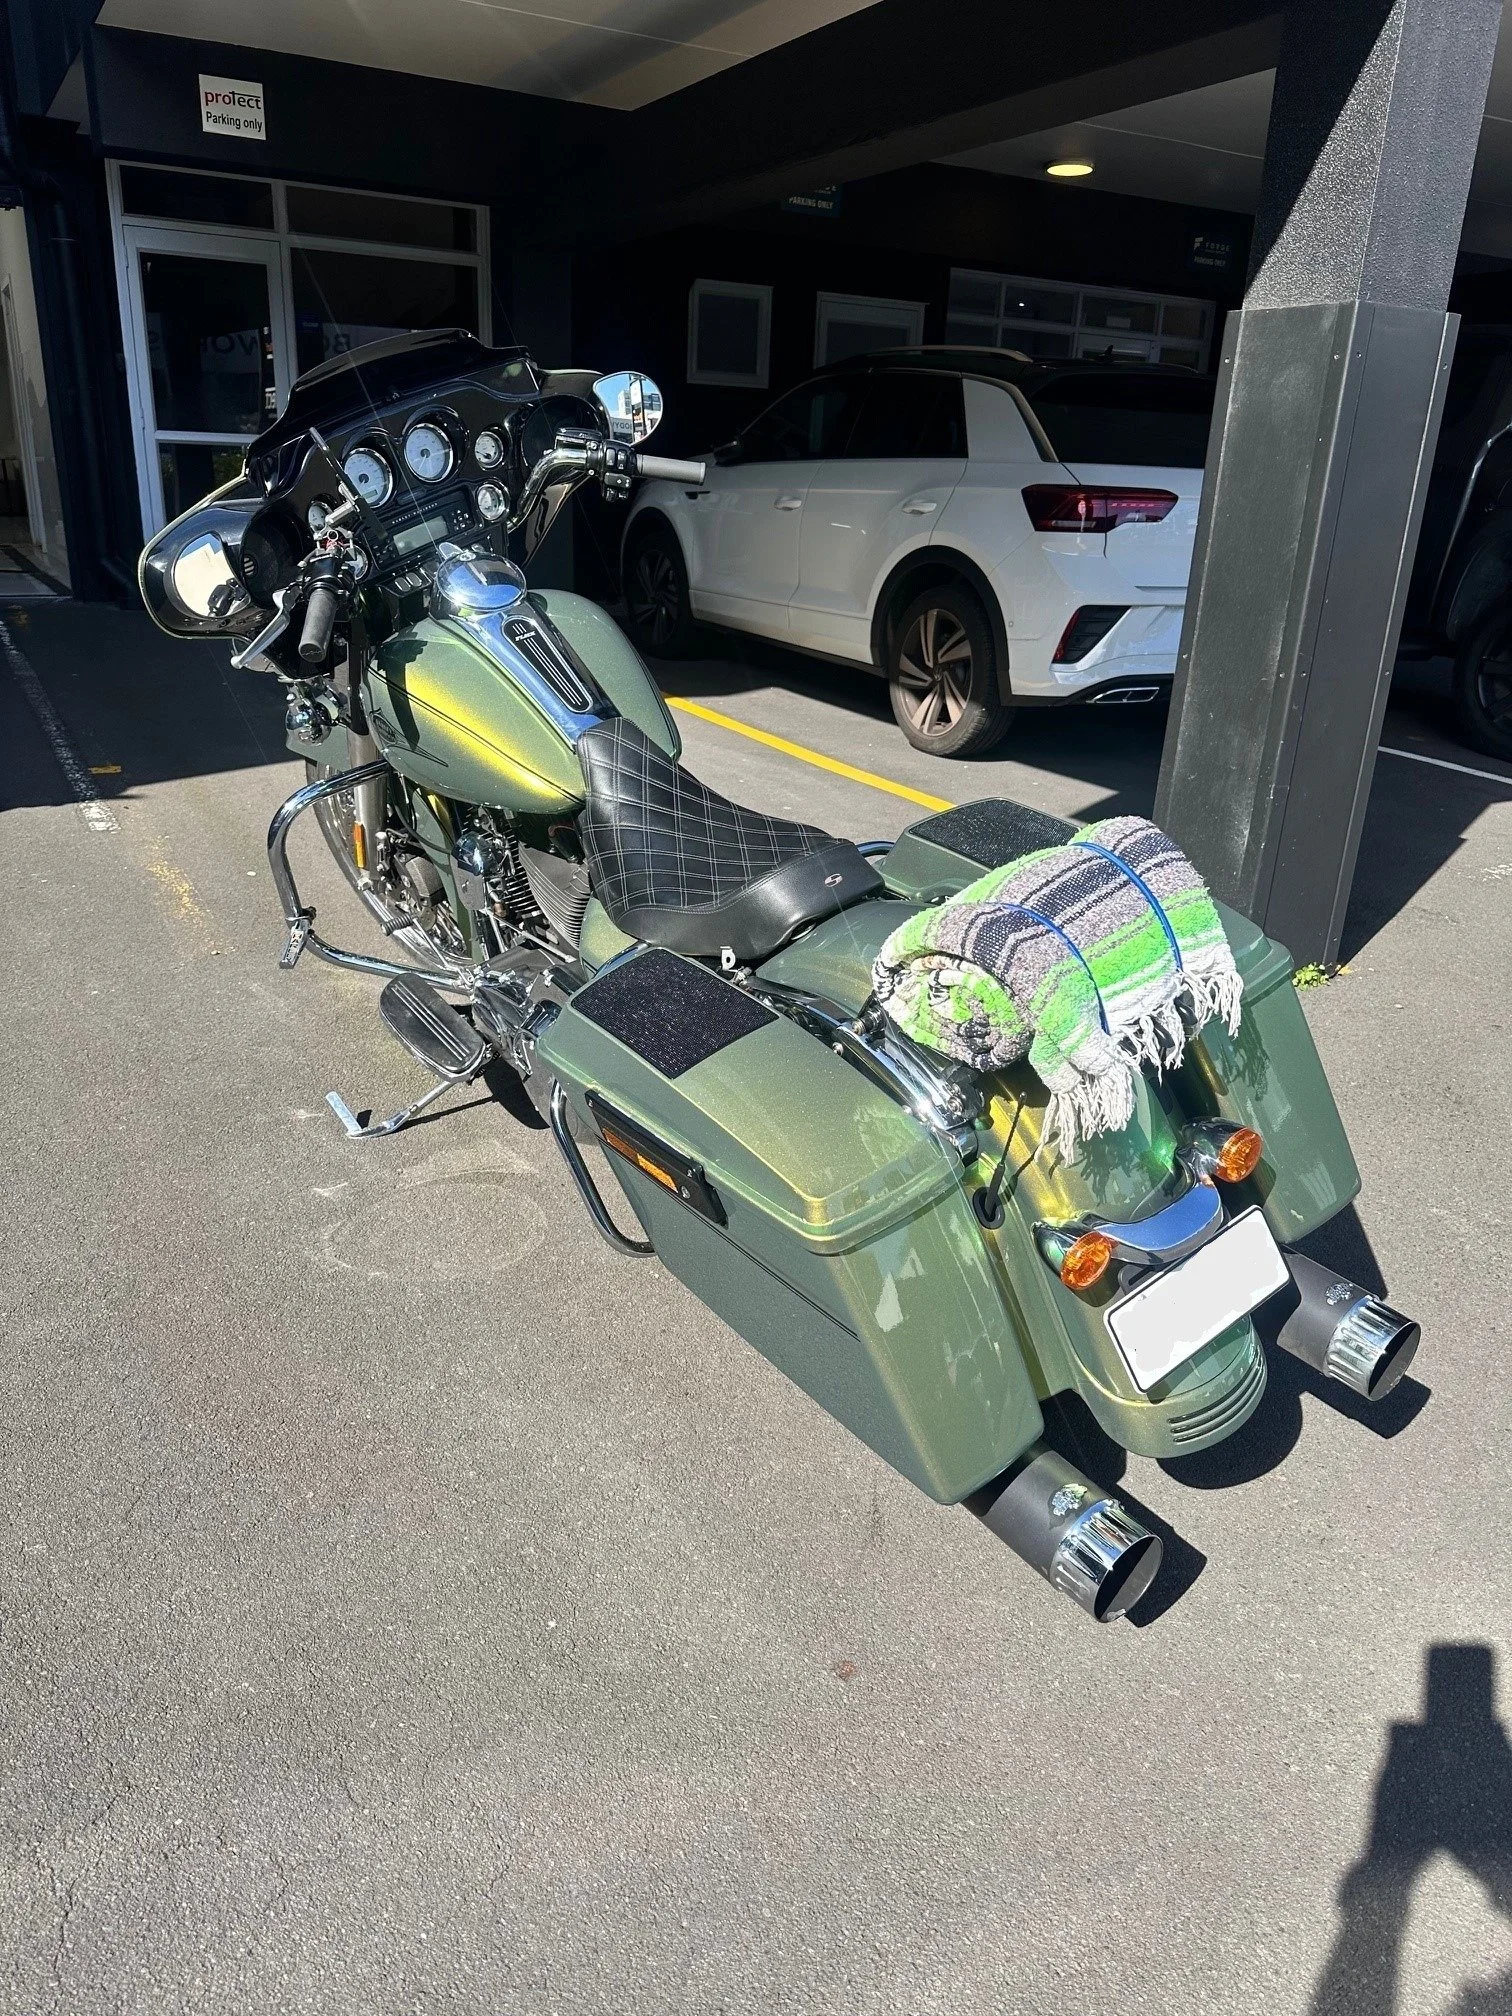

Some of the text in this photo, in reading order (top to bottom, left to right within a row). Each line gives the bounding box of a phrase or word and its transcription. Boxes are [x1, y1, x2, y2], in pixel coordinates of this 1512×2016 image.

[206, 111, 263, 133] Parking only
[788, 196, 834, 209] PARKING ONLY
